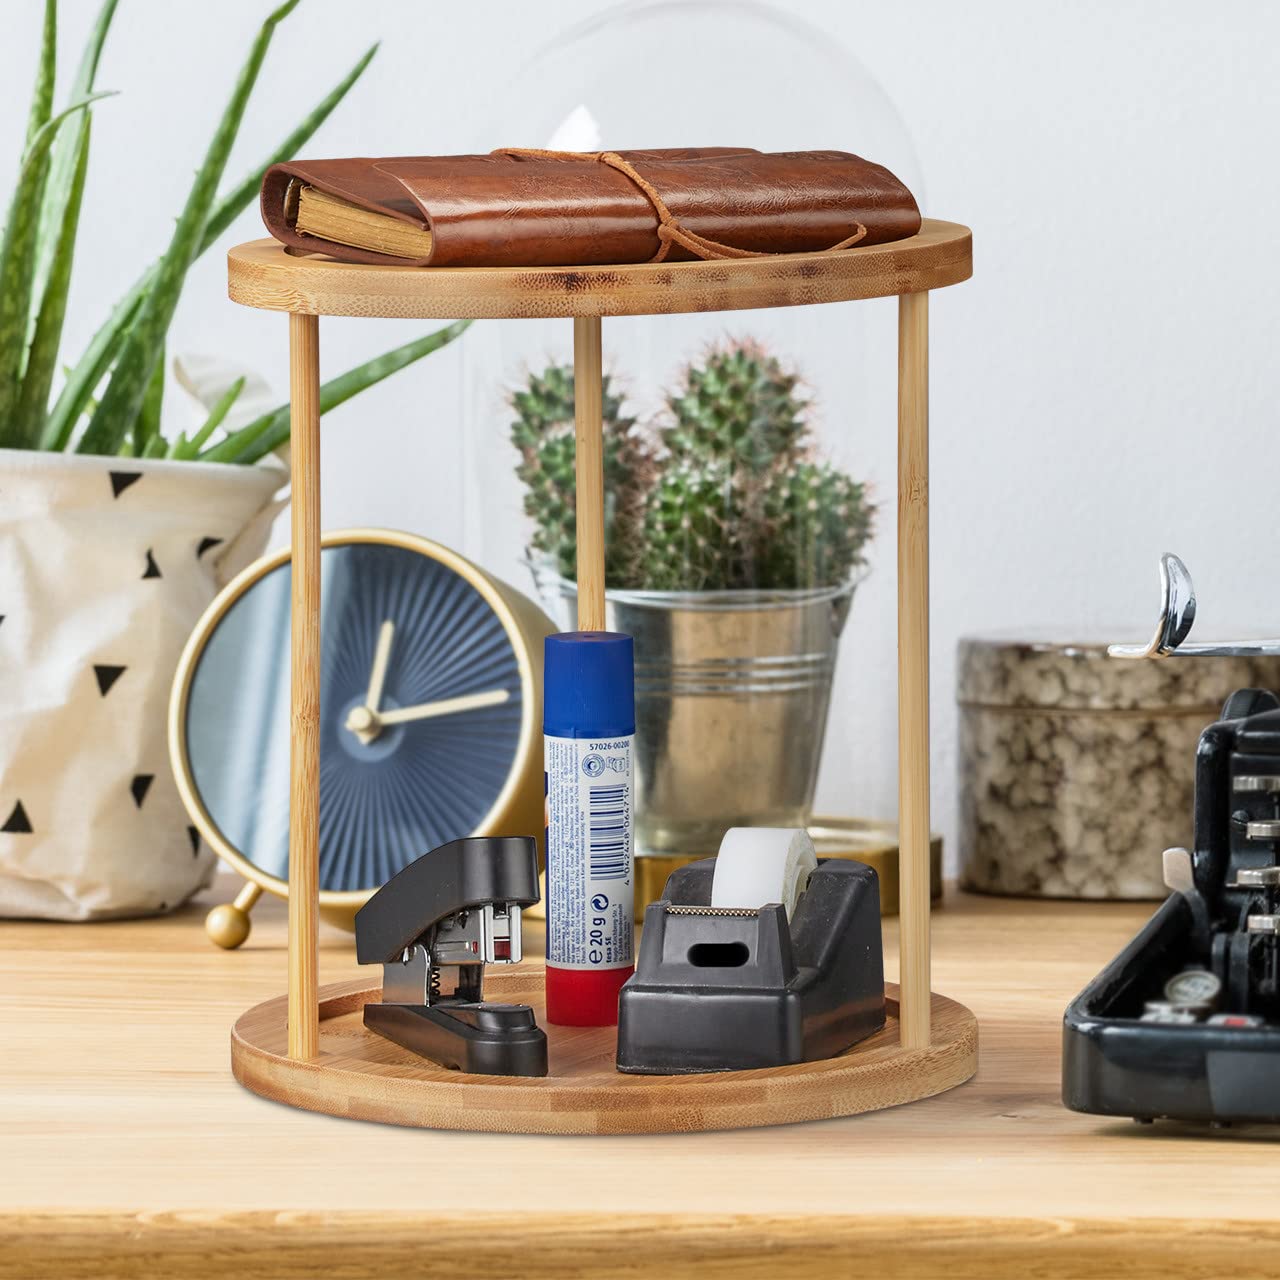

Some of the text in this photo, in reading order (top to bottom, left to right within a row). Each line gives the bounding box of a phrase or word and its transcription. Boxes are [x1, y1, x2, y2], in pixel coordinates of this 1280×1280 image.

[592, 917, 606, 926] g
[589, 929, 603, 946] 20
[605, 936, 612, 946] SE
